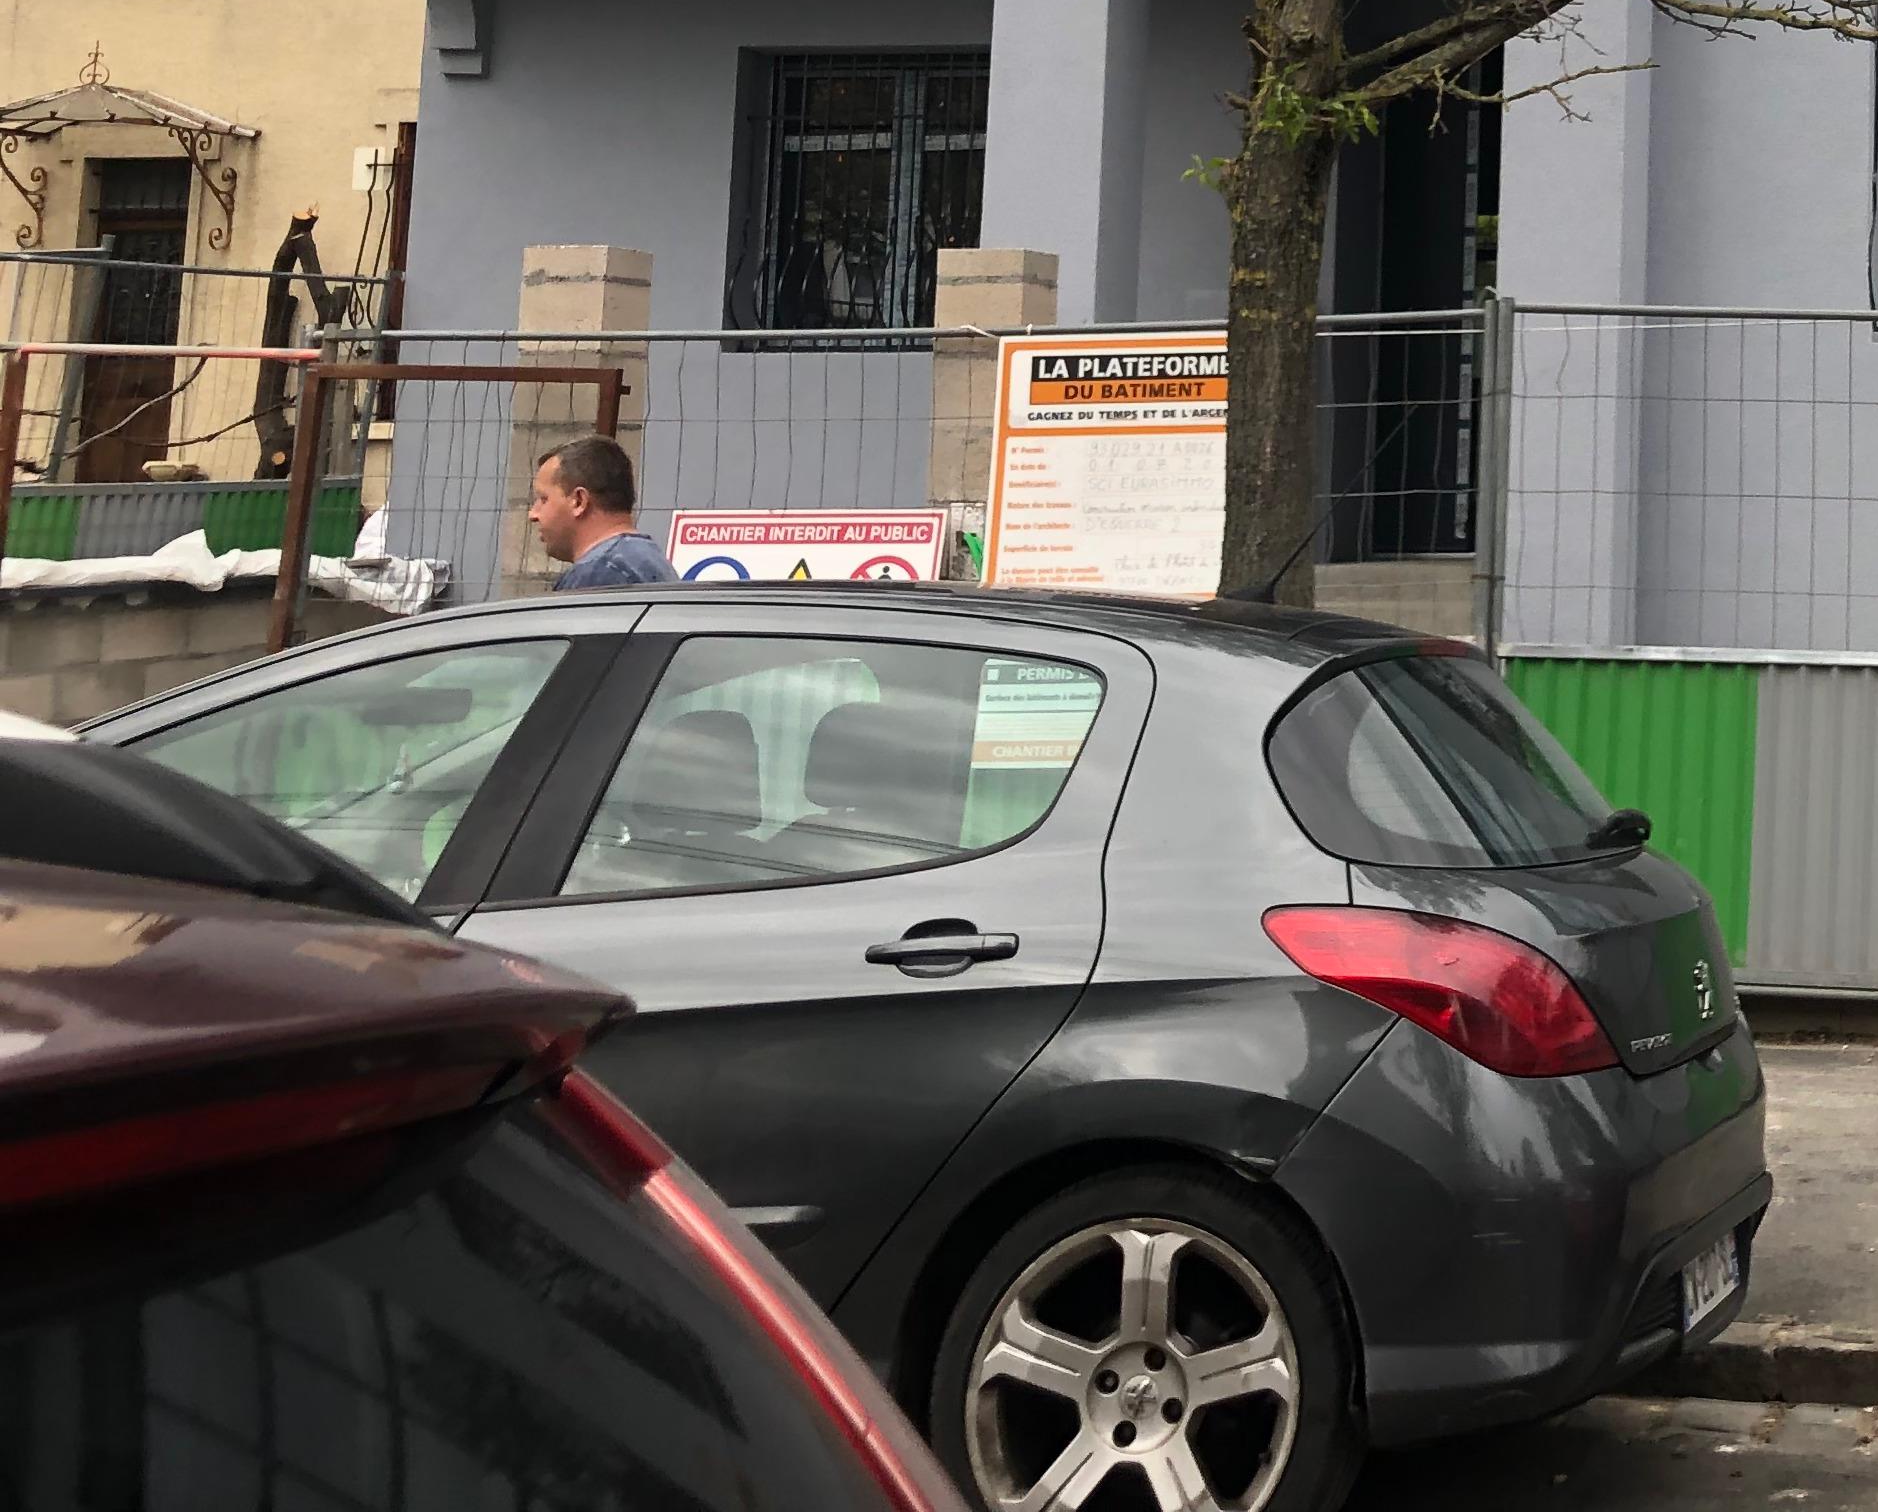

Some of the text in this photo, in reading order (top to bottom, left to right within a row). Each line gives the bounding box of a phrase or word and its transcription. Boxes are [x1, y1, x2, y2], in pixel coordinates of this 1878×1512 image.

[1038, 355, 1230, 379] LA PLATEFORME
[1063, 382, 1206, 400] DU BATIMENT
[1027, 411, 1074, 421] GAGNEZ
[1078, 410, 1094, 420] DU
[1099, 410, 1138, 420] TEMPS
[1143, 409, 1157, 419] ET
[1162, 409, 1177, 419] DE
[684, 525, 929, 542] CHANTIER INTERDIT AU PUBLIC
[1017, 667, 1075, 681] PERMIS
[992, 745, 1065, 757] CHANTIER
